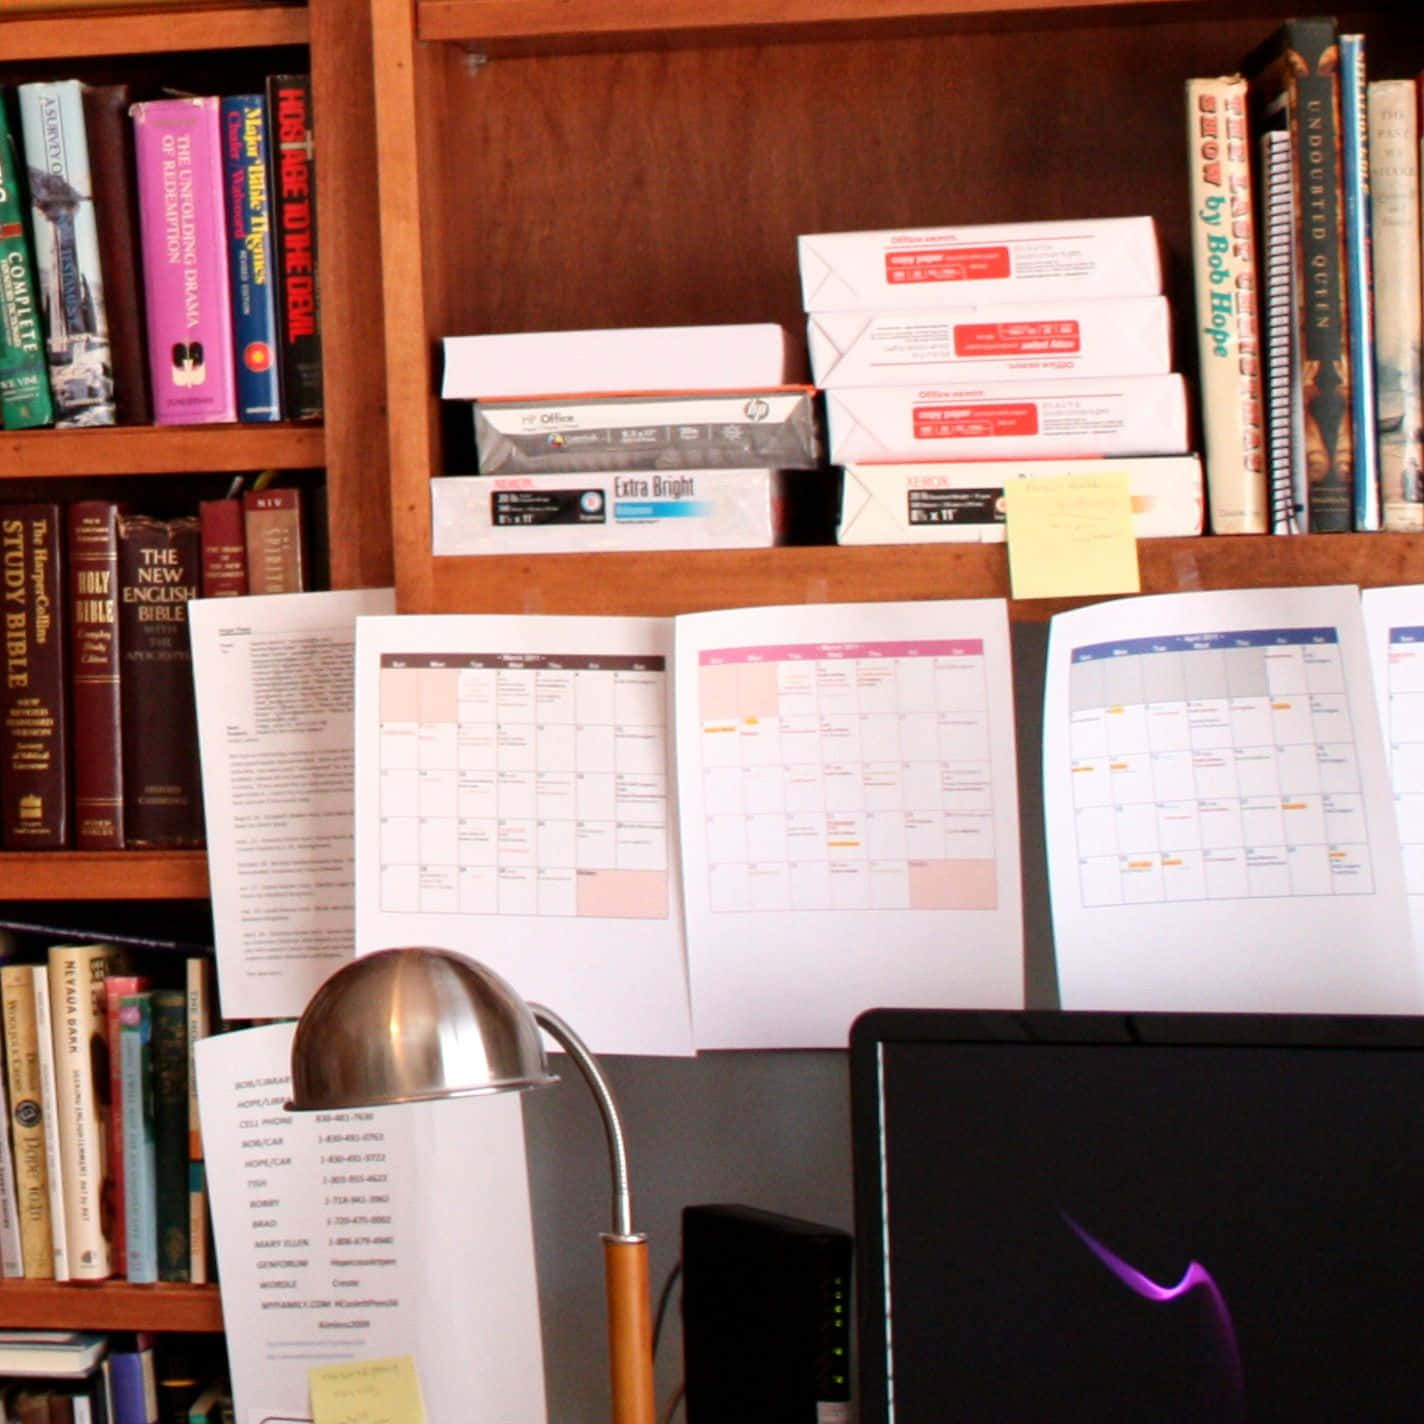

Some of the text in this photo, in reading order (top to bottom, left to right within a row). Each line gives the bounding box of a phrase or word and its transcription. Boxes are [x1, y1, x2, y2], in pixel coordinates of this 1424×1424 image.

[162, 136, 181, 264] OF REDEMPTION
[177, 136, 200, 327] THE UNFOLDING DRAMA
[1199, 94, 1234, 357] SHOW by Bob Hope
[1306, 101, 1330, 329] UNDOUBTED QUEEN
[7, 252, 38, 352] COMPLETE
[614, 476, 694, 499] Extra Bright
[4, 521, 28, 688] STUDY BIBLE
[32, 521, 51, 644] The HarperCollins
[124, 586, 196, 602] ENGLISH
[138, 567, 184, 583] NEW
[141, 549, 178, 564] THE
[138, 605, 185, 621] BIBLE
